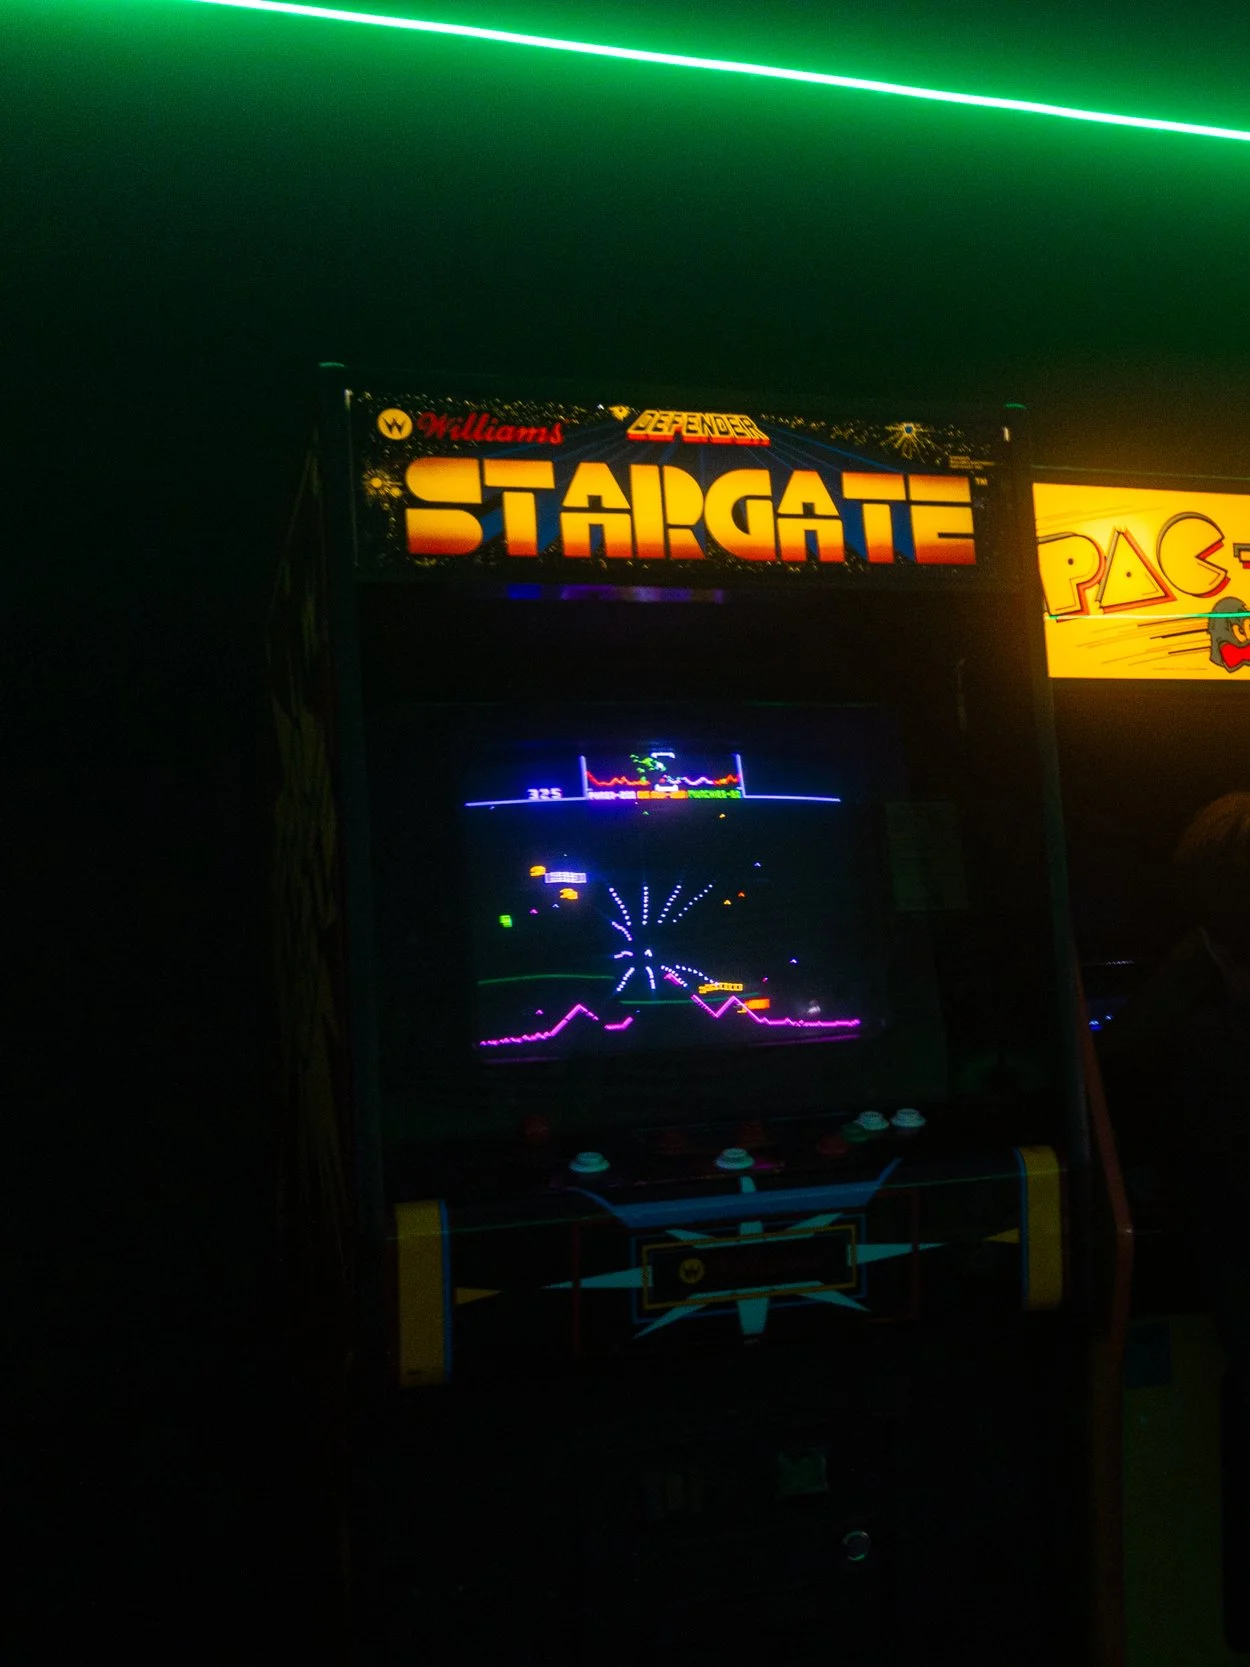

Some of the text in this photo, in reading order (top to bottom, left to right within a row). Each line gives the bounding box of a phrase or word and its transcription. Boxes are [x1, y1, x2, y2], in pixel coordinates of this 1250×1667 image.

[417, 411, 564, 445] Williams
[626, 409, 771, 446] DEFENDER
[405, 456, 976, 565] STARGATE
[527, 788, 562, 800] 325
